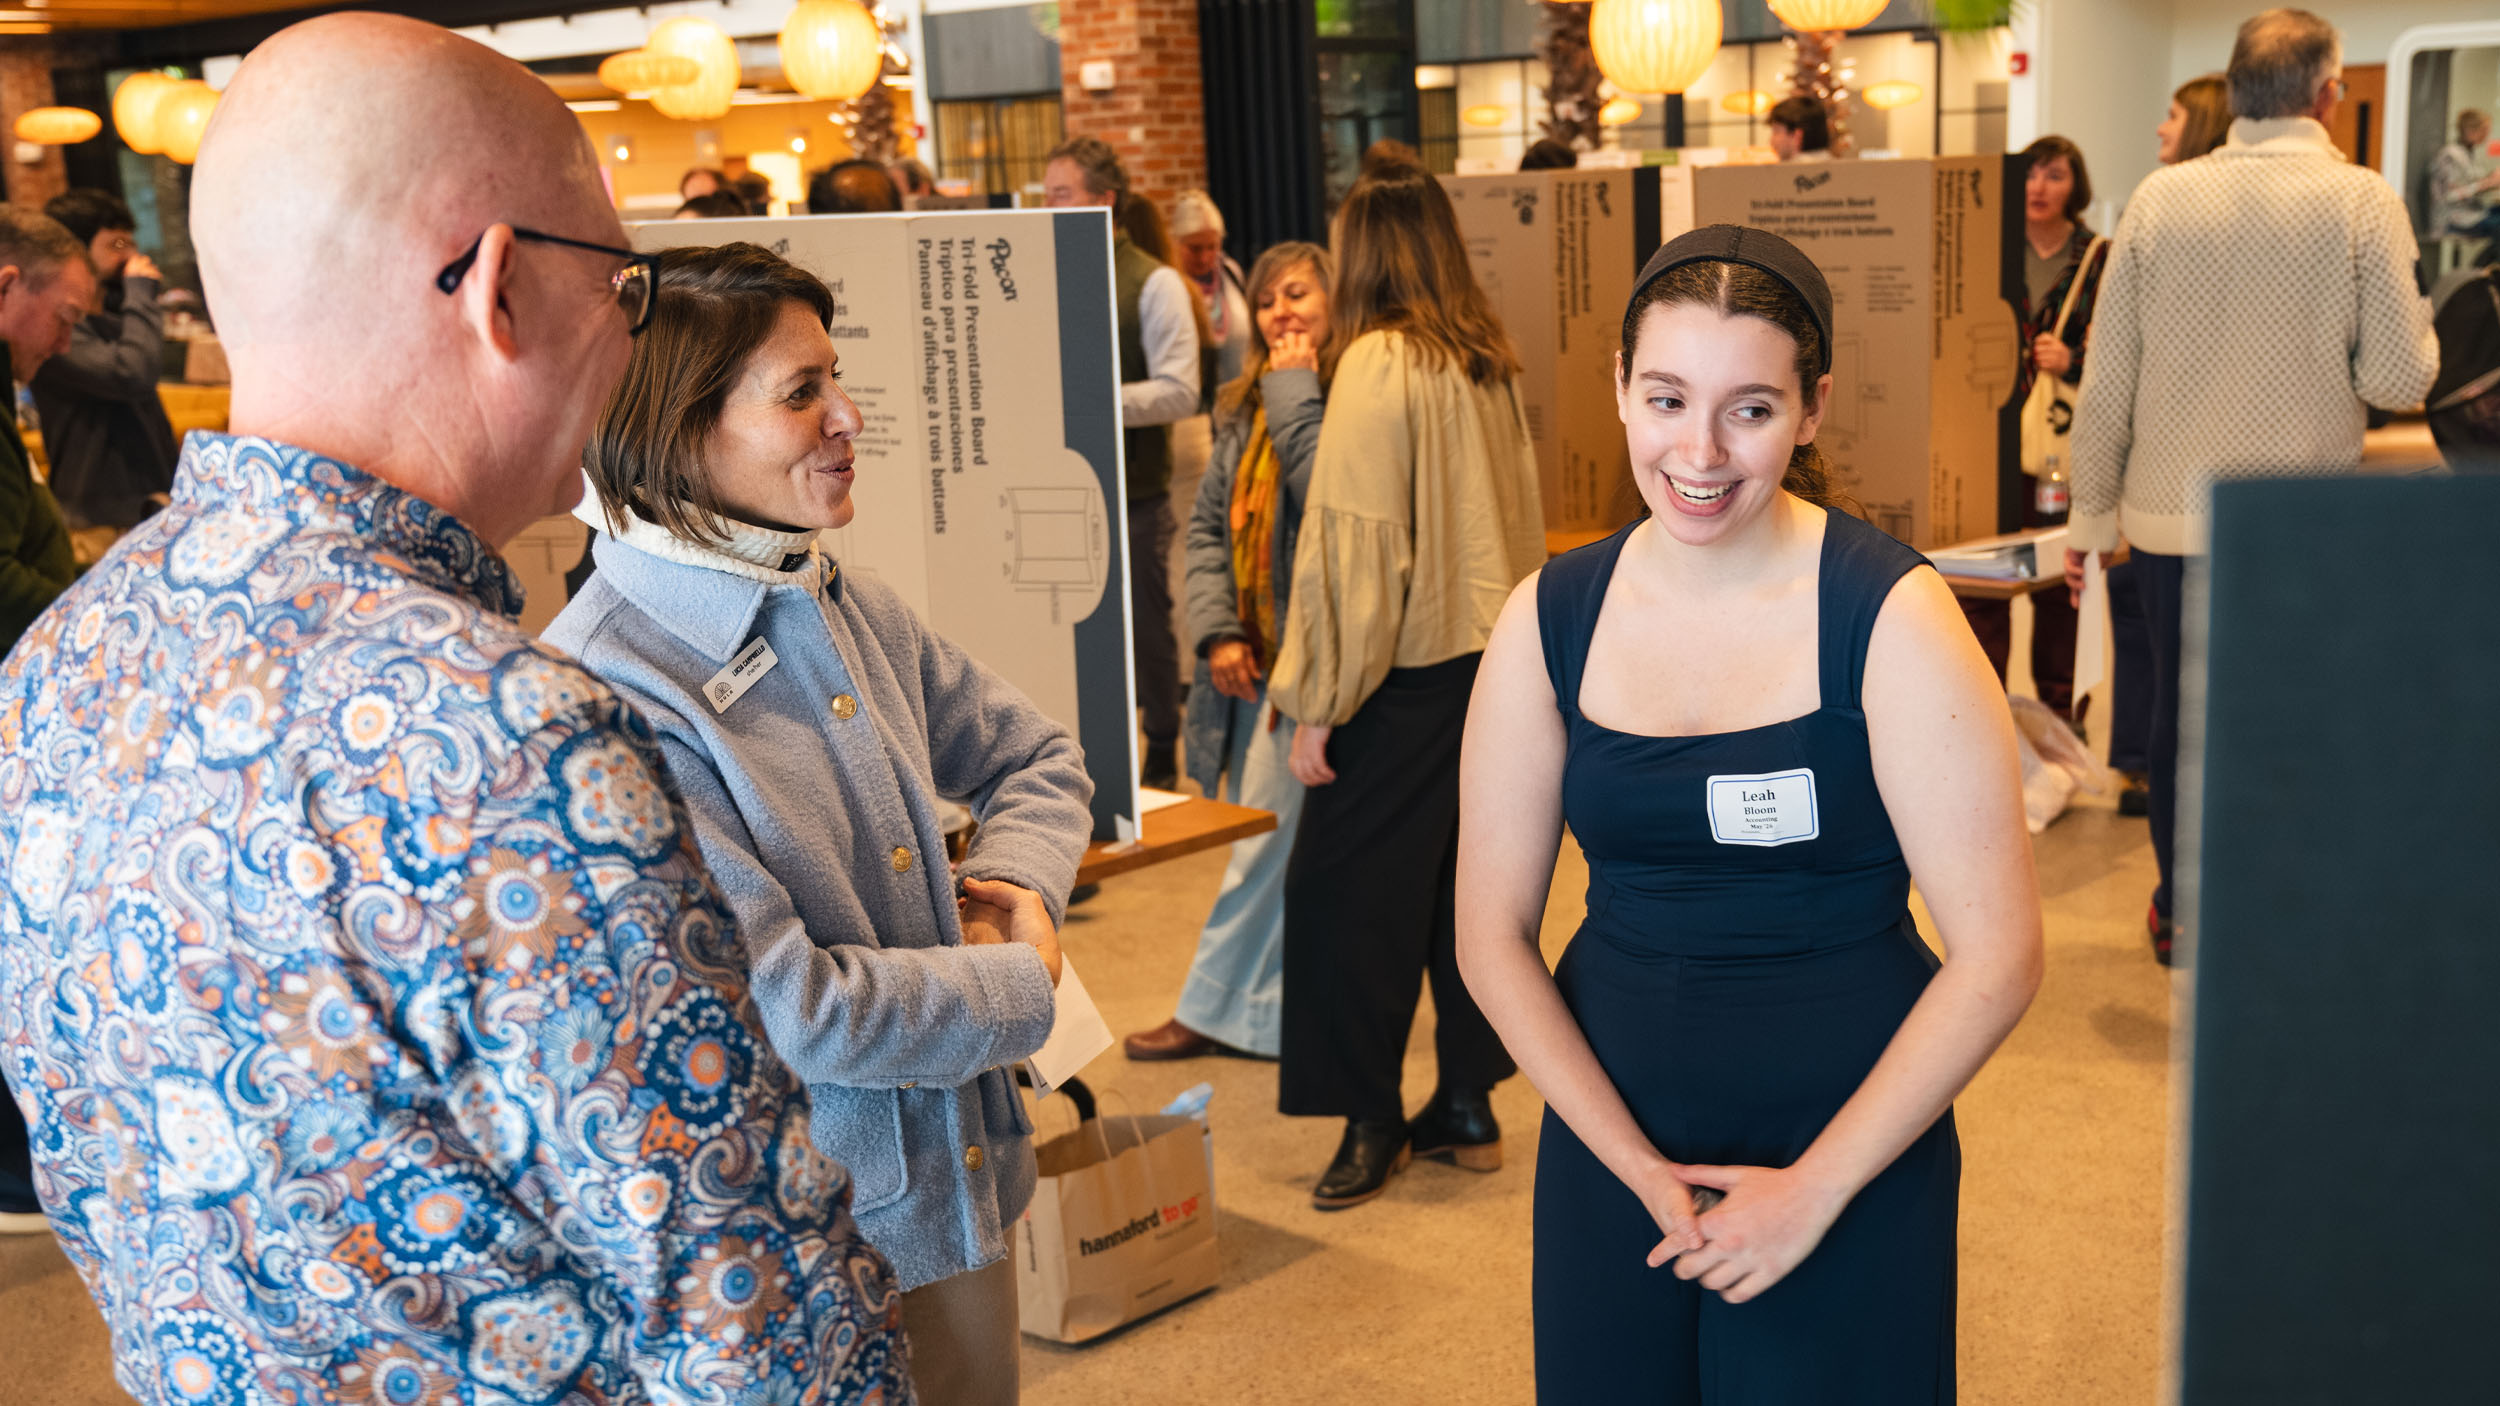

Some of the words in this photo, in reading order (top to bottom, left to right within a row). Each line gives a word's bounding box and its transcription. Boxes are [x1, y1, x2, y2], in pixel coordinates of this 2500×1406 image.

[918, 239, 933, 311] Panneau
[961, 237, 980, 300] Tri-Fold
[985, 237, 1019, 302] Pacon
[830, 326, 870, 339] attants
[939, 306, 956, 343] para
[922, 316, 940, 405] d'affichage
[965, 305, 984, 411] Presentation
[942, 349, 965, 474] presentaciones
[971, 417, 989, 466] Board
[928, 425, 944, 463] trois
[931, 468, 947, 535] battants
[1742, 789, 1776, 803] Leah
[1744, 805, 1777, 815] Bloom
[1080, 1209, 1160, 1256] hannaford
[1162, 1205, 1179, 1222] to
[1181, 1196, 1198, 1217] go
